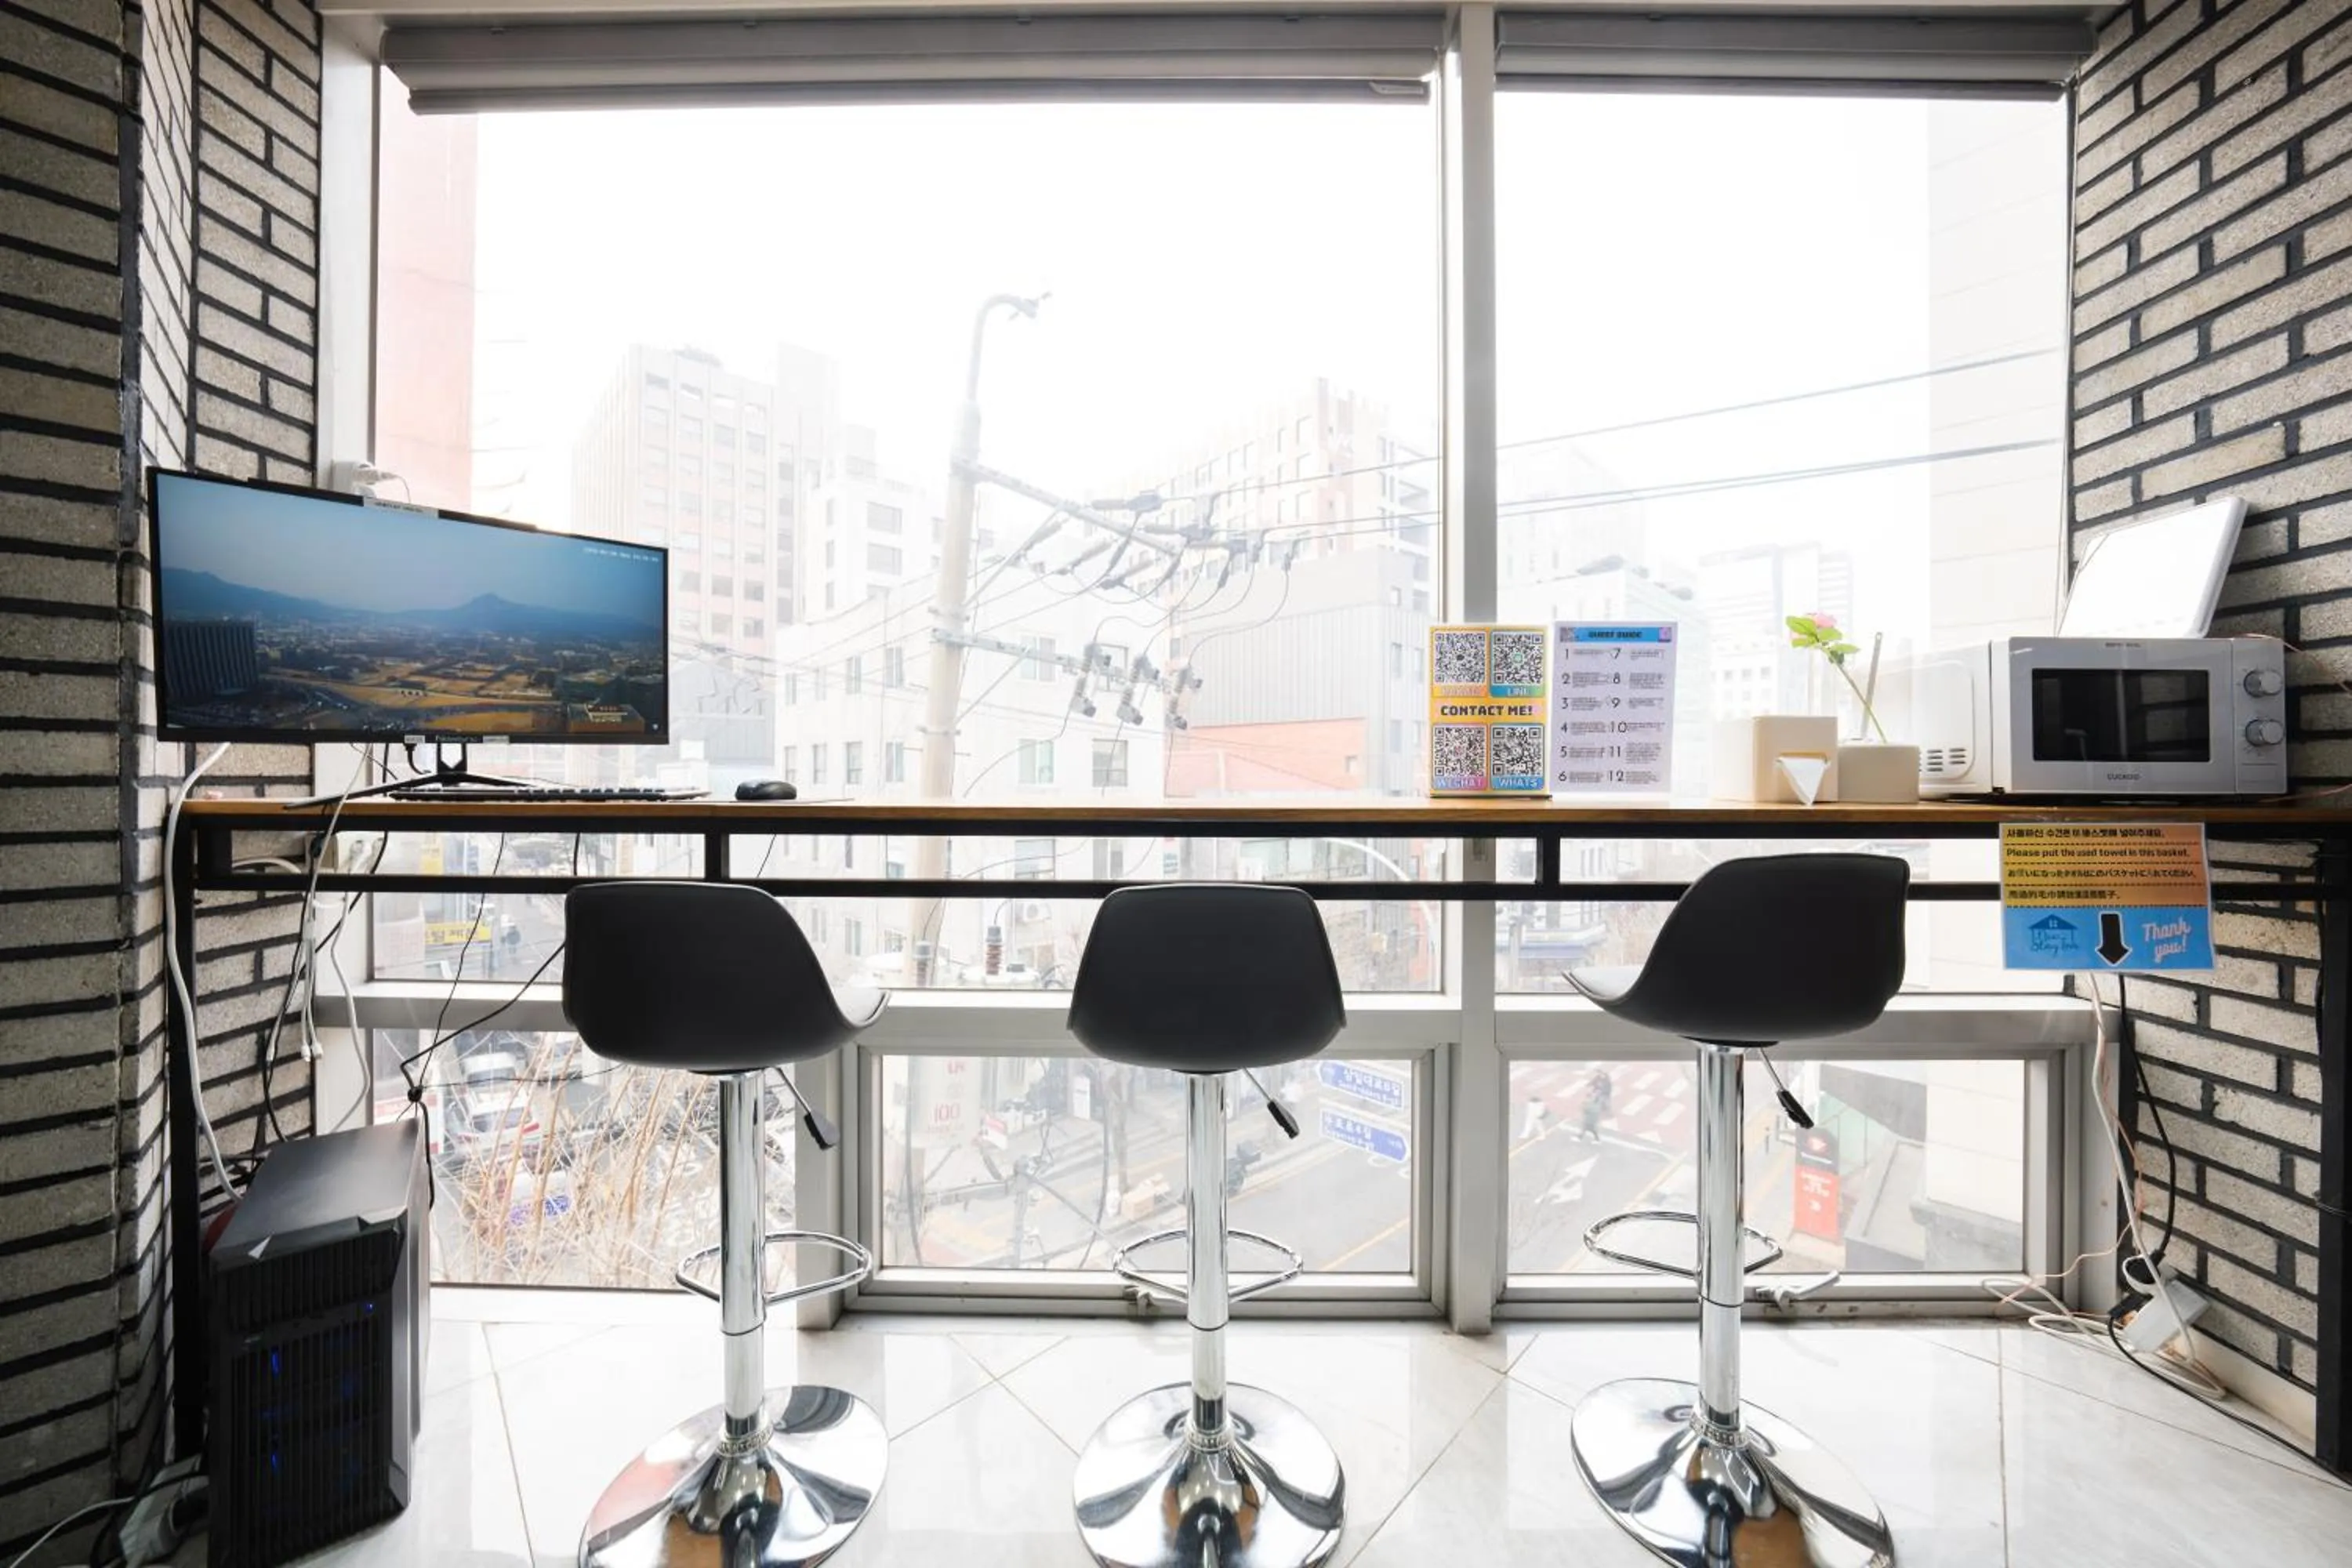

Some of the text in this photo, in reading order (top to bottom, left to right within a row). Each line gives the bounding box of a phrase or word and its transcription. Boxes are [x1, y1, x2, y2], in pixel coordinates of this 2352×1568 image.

[1613, 648, 1622, 659] 7
[1561, 672, 1570, 684] 2
[1613, 672, 1621, 684] 8
[1561, 697, 1569, 710] 3
[1611, 697, 1621, 709] 9
[1440, 705, 1533, 716] CONTACT ME!
[1560, 721, 1568, 733] 4
[1610, 720, 1628, 733] 10
[1559, 746, 1567, 758] 5
[1609, 746, 1621, 758] 11
[1558, 771, 1567, 782] 6
[1609, 770, 1625, 782] 12
[1498, 777, 1538, 789] WHATS
[2007, 848, 2040, 857] Please
[2042, 849, 2059, 858] put
[2060, 848, 2075, 857] the
[2099, 848, 2127, 857] towel
[2138, 848, 2155, 857] this
[2157, 848, 2190, 857] basket.
[2141, 916, 2192, 942] Thank
[2154, 934, 2187, 964] you!
